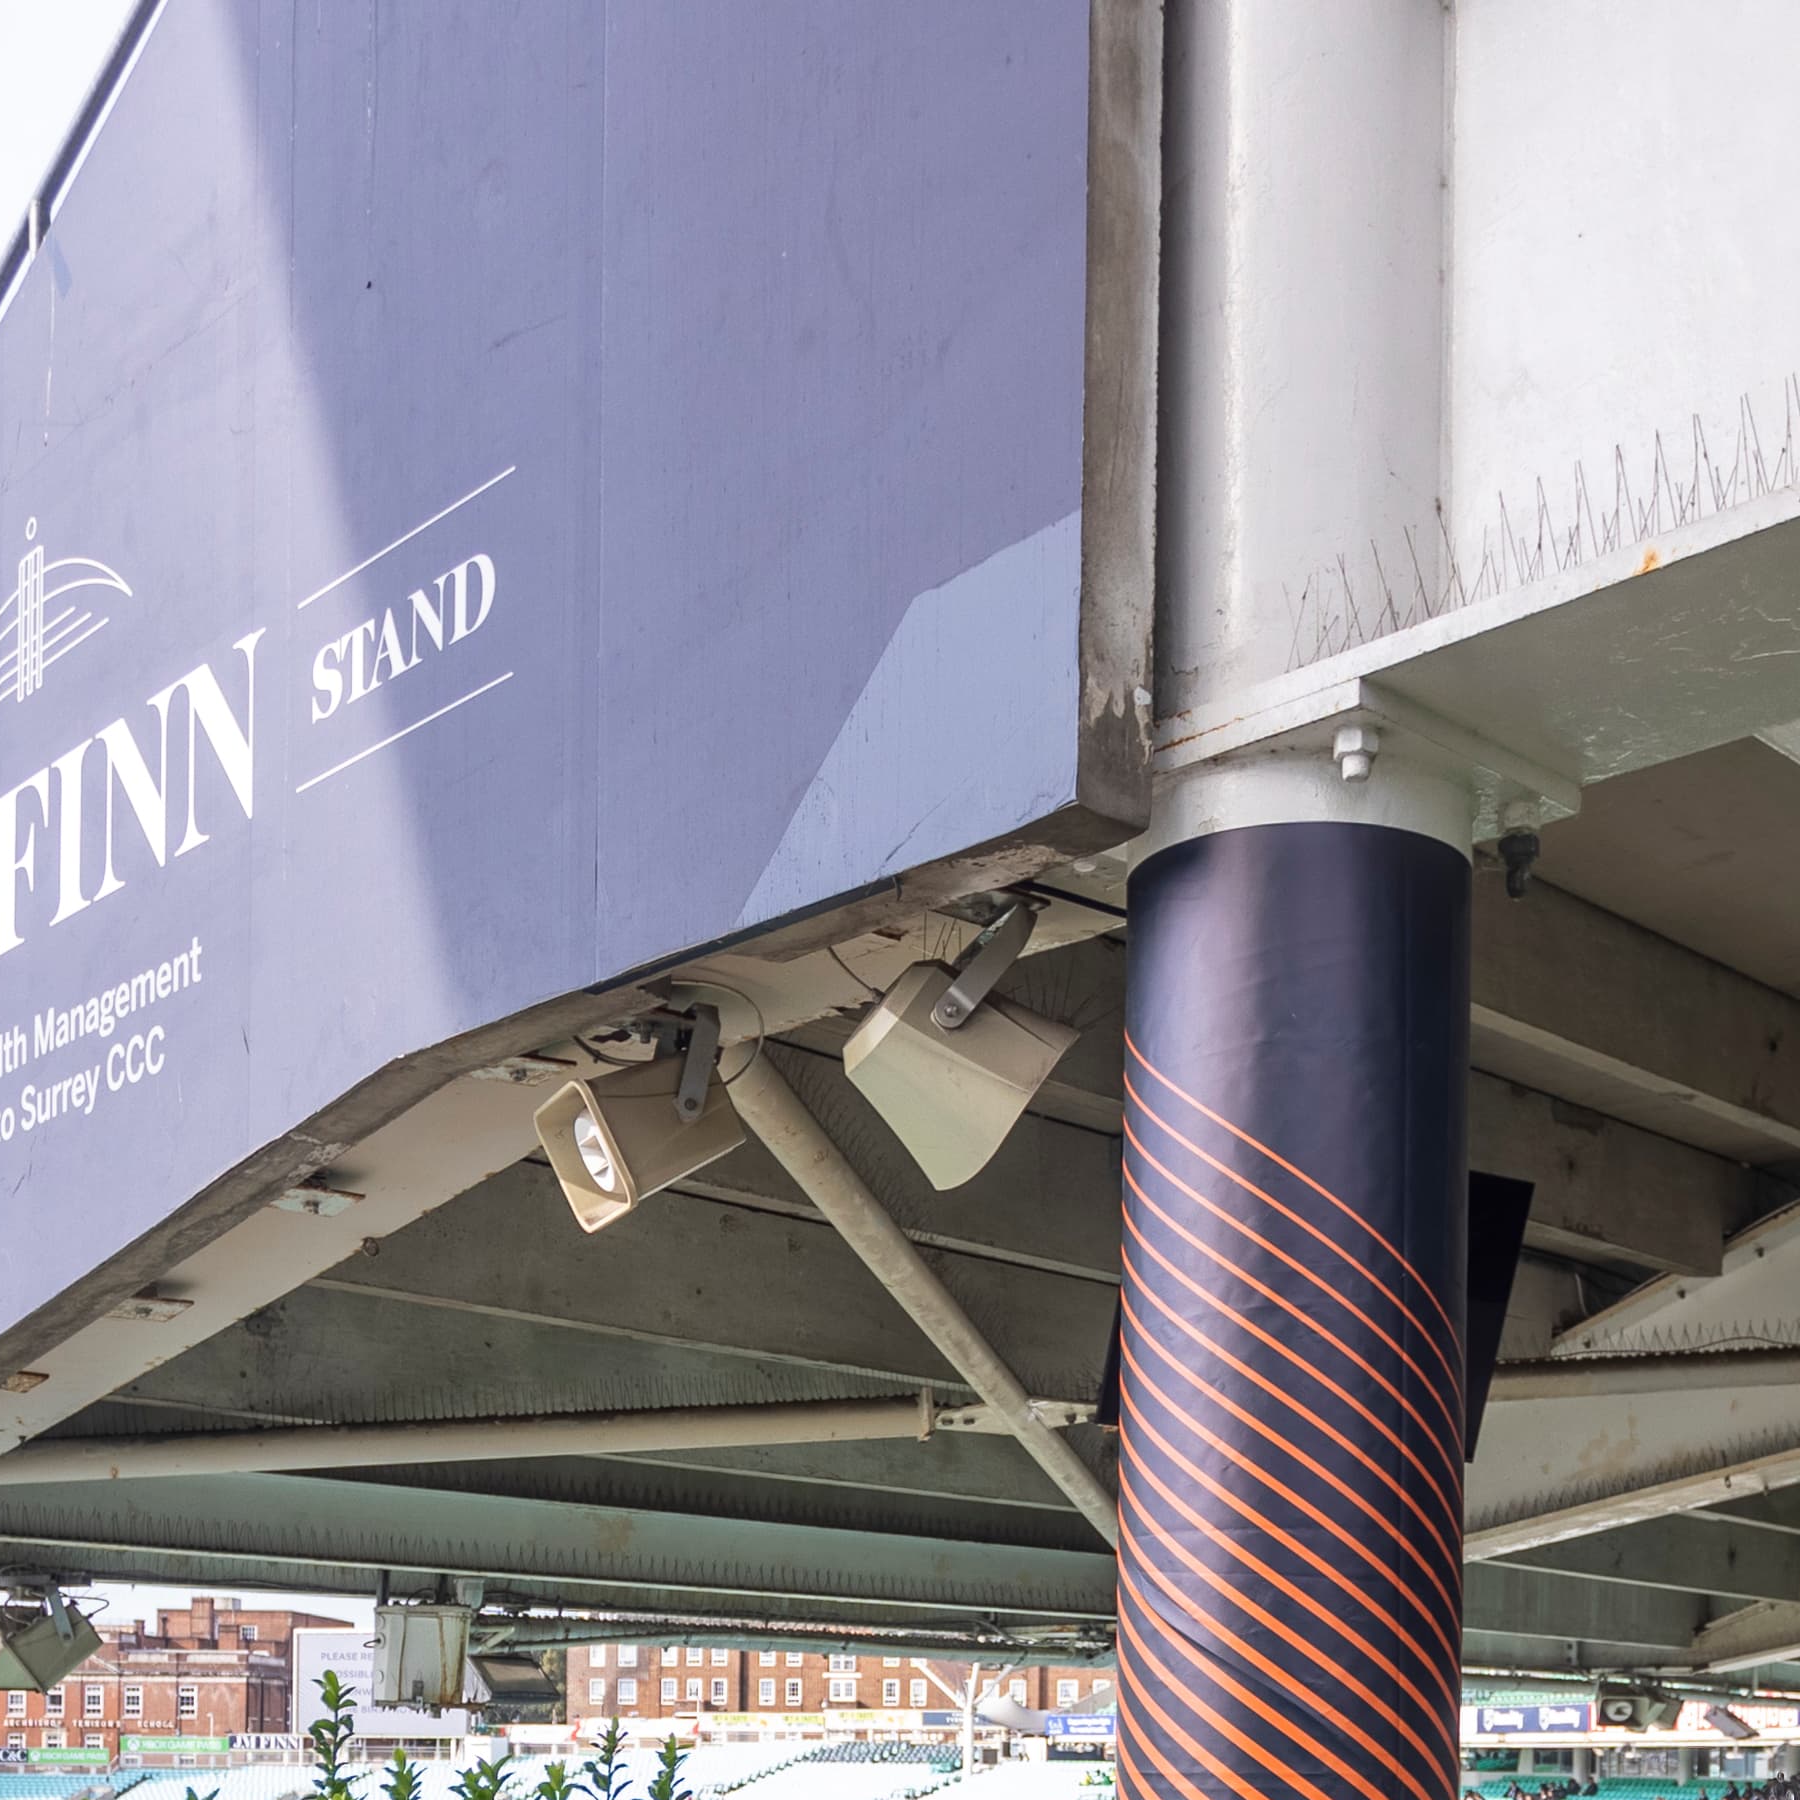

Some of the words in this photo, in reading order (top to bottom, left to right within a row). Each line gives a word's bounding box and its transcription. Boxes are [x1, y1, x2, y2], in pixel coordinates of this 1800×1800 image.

[310, 551, 498, 725] STAND
[32, 936, 203, 1059] Management
[19, 1064, 99, 1129] Surrey
[104, 1024, 167, 1095] CCC
[320, 1652, 358, 1661] PLEASE
[260, 1735, 299, 1749] FINN
